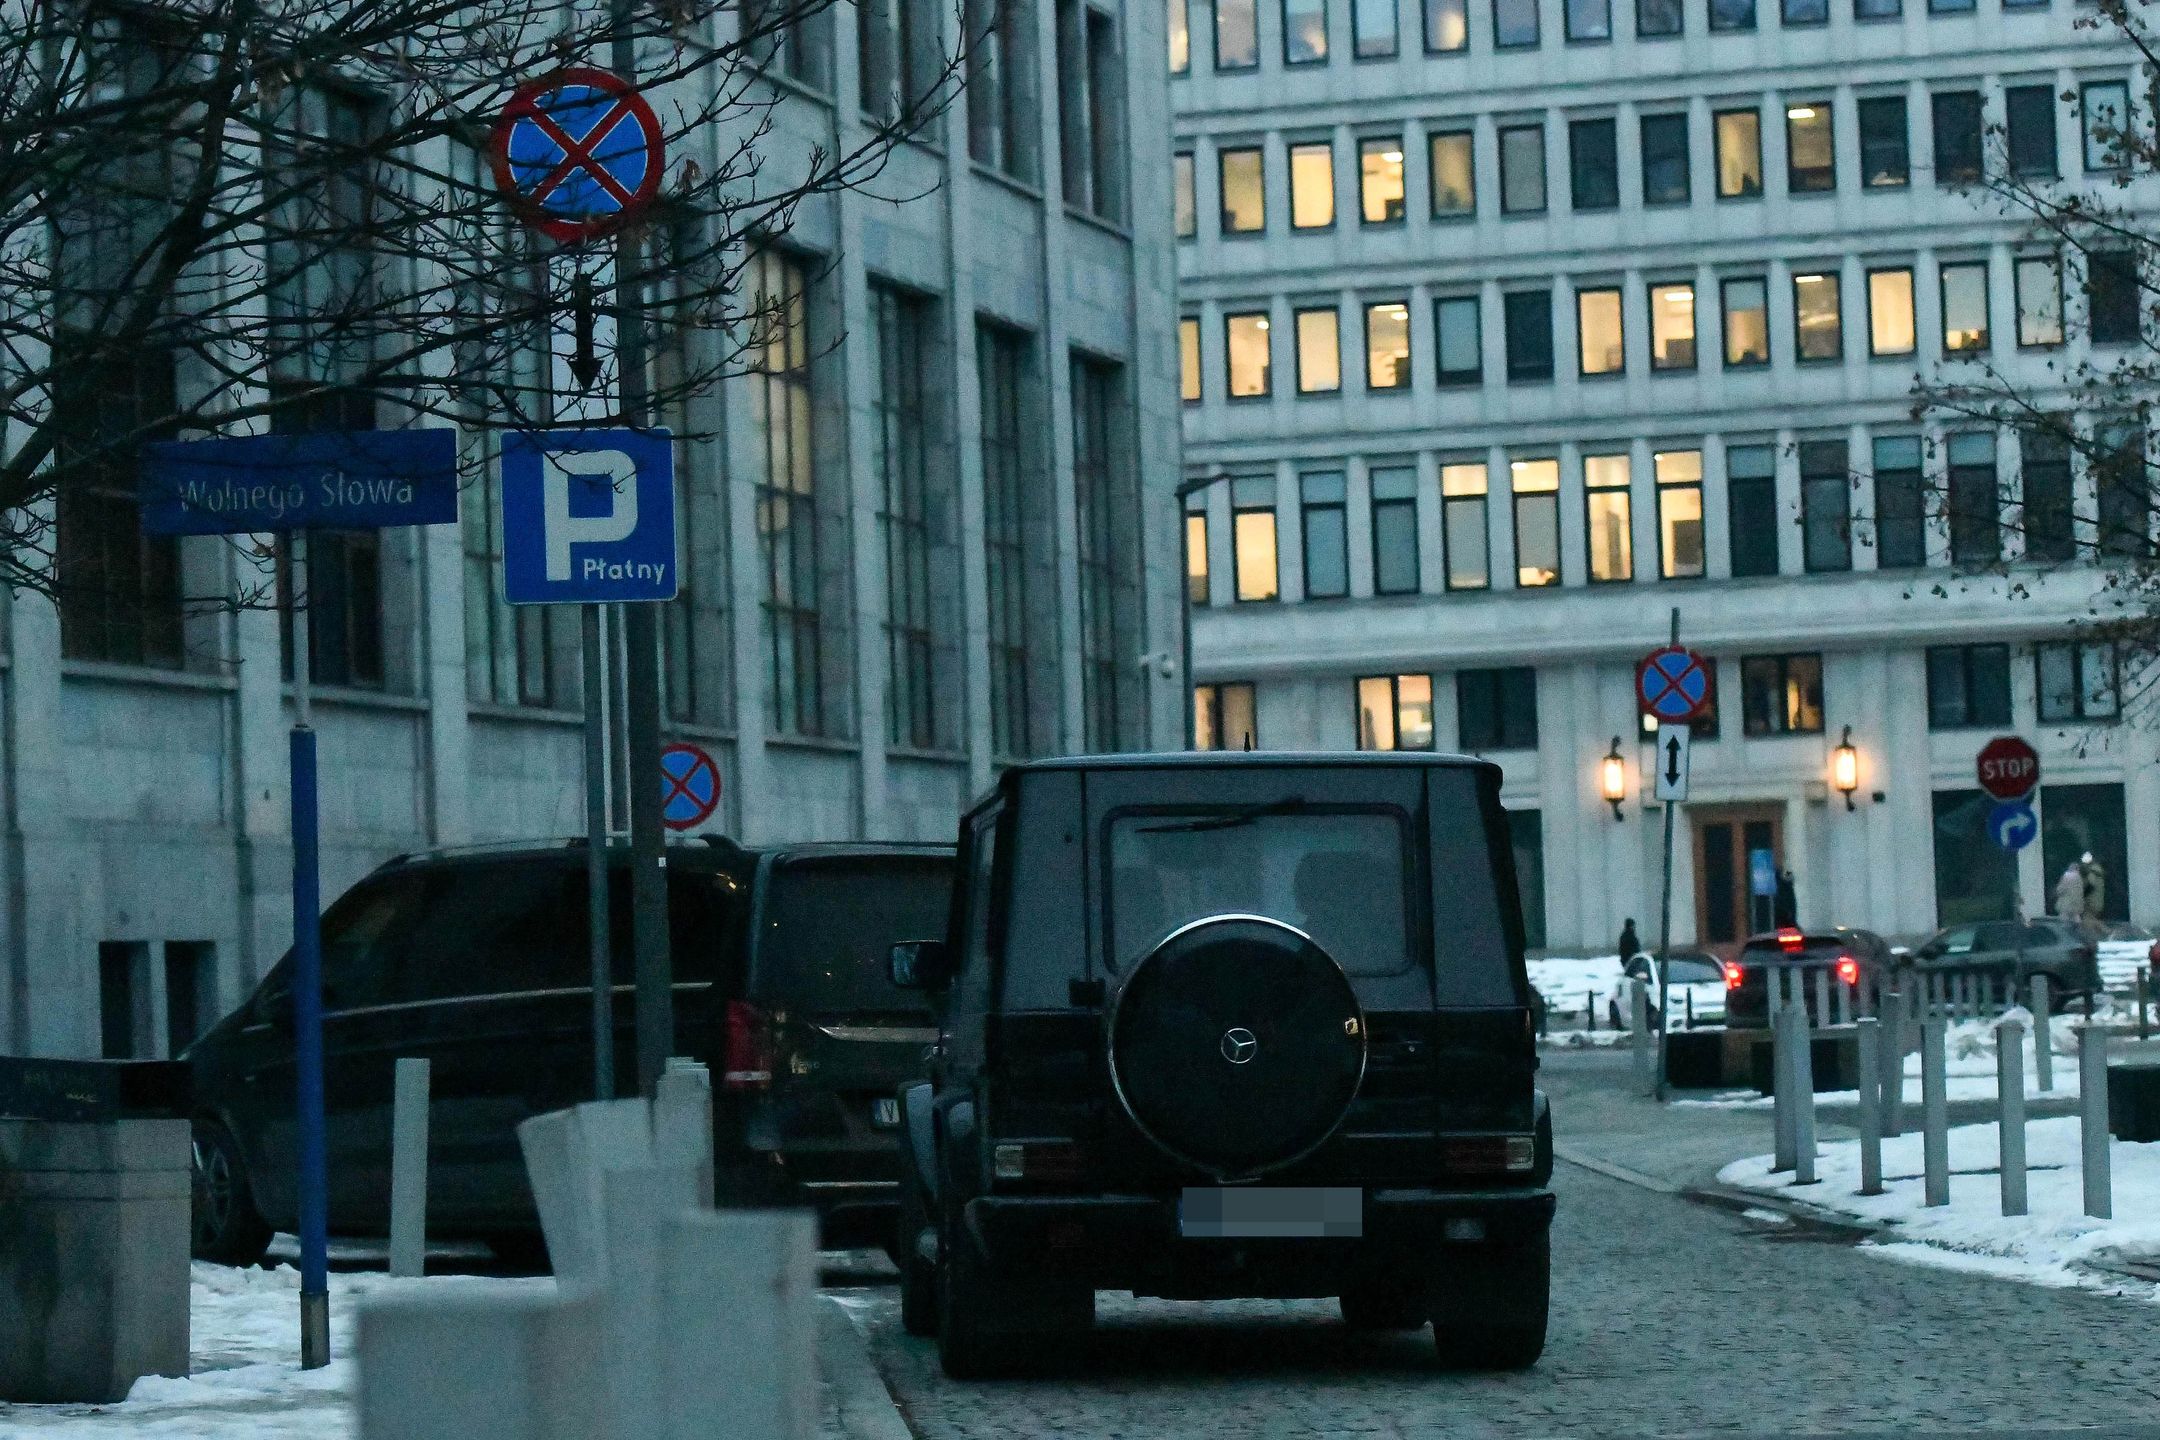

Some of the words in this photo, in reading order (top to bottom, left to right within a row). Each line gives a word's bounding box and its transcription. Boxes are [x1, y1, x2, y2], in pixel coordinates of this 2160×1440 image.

[177, 478, 305, 520] Wolnego
[542, 449, 639, 582] P
[583, 557, 666, 586] Płatny
[1983, 757, 2035, 780] STOP
